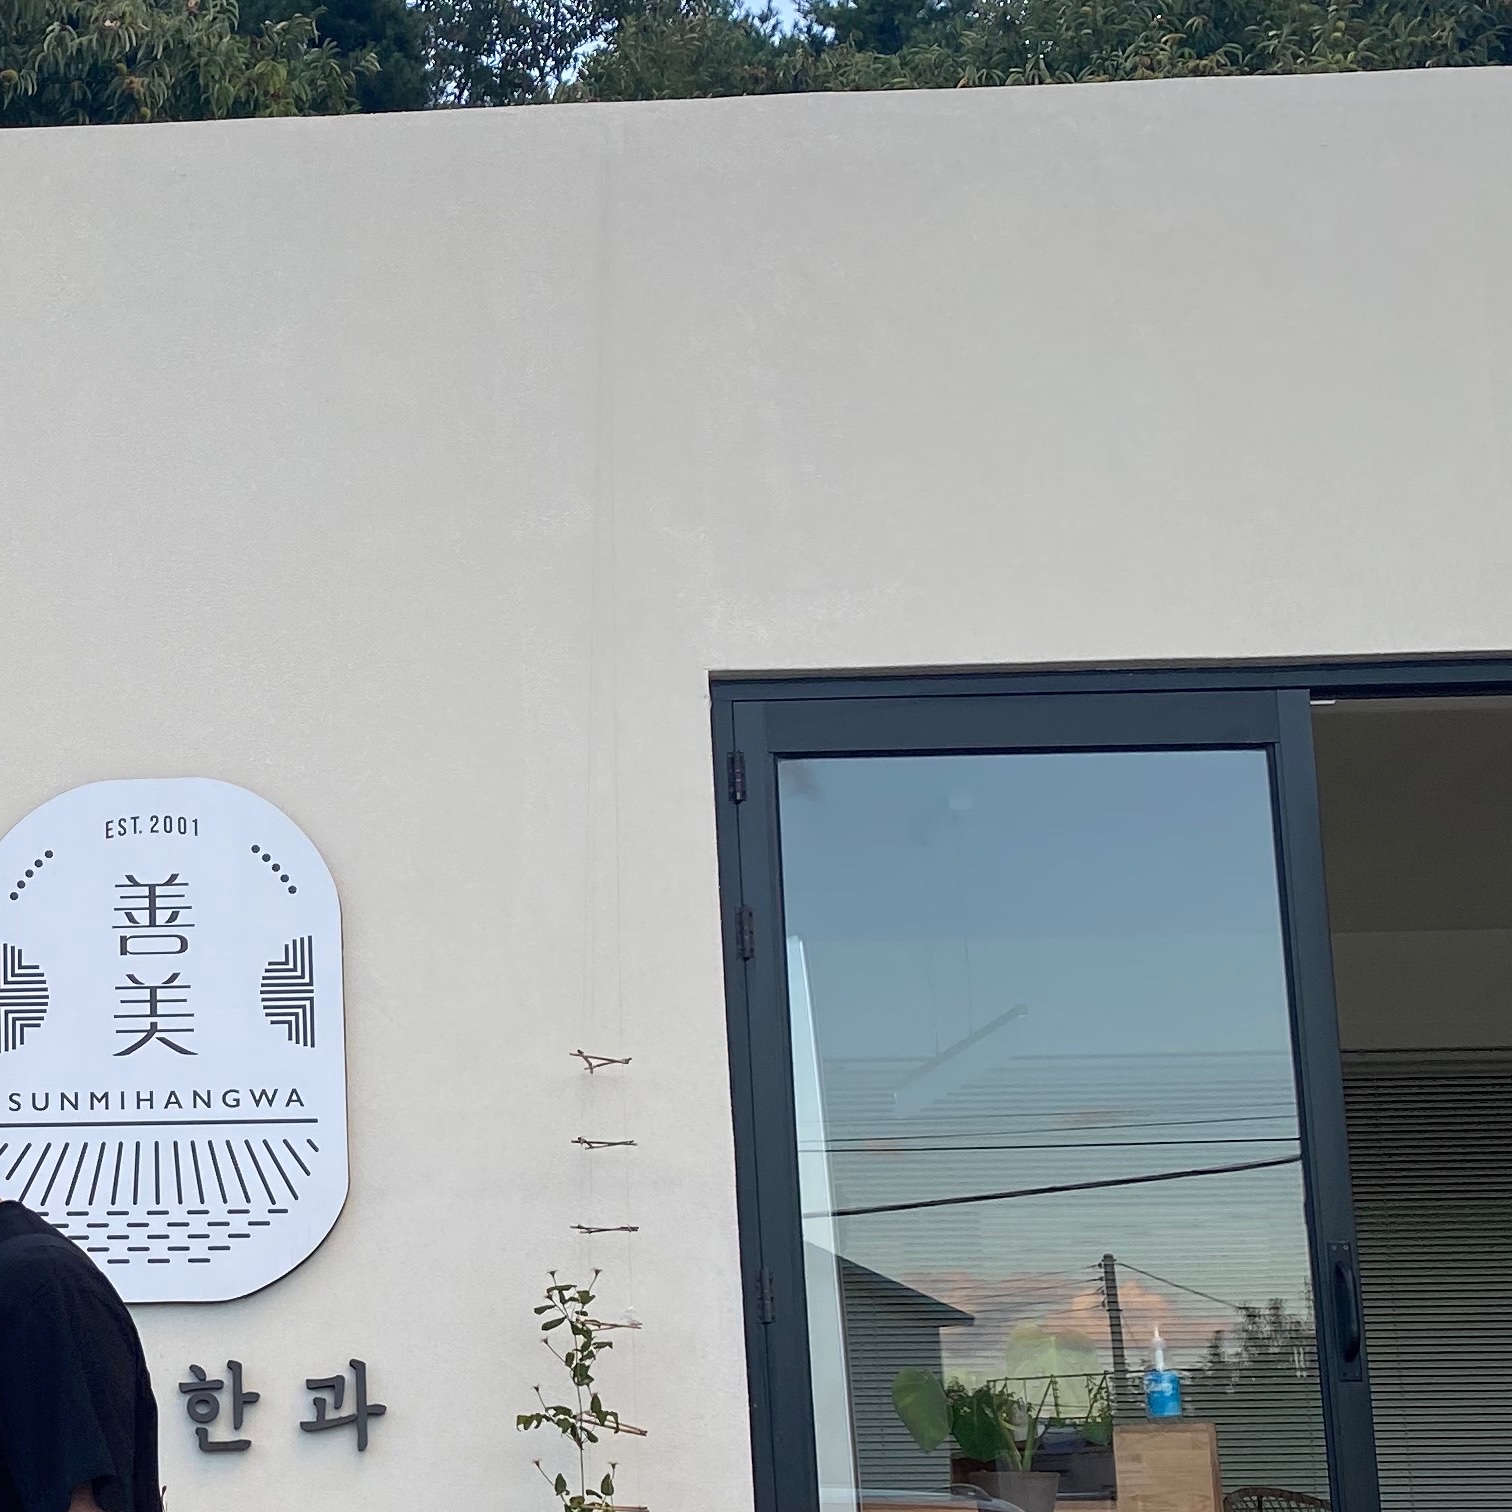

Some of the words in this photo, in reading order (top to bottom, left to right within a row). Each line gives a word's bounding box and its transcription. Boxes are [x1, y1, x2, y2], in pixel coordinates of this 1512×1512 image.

[105, 815, 143, 839] EST.
[149, 814, 199, 837] 2001
[8, 1087, 305, 1112] SUNMIHANGWA
